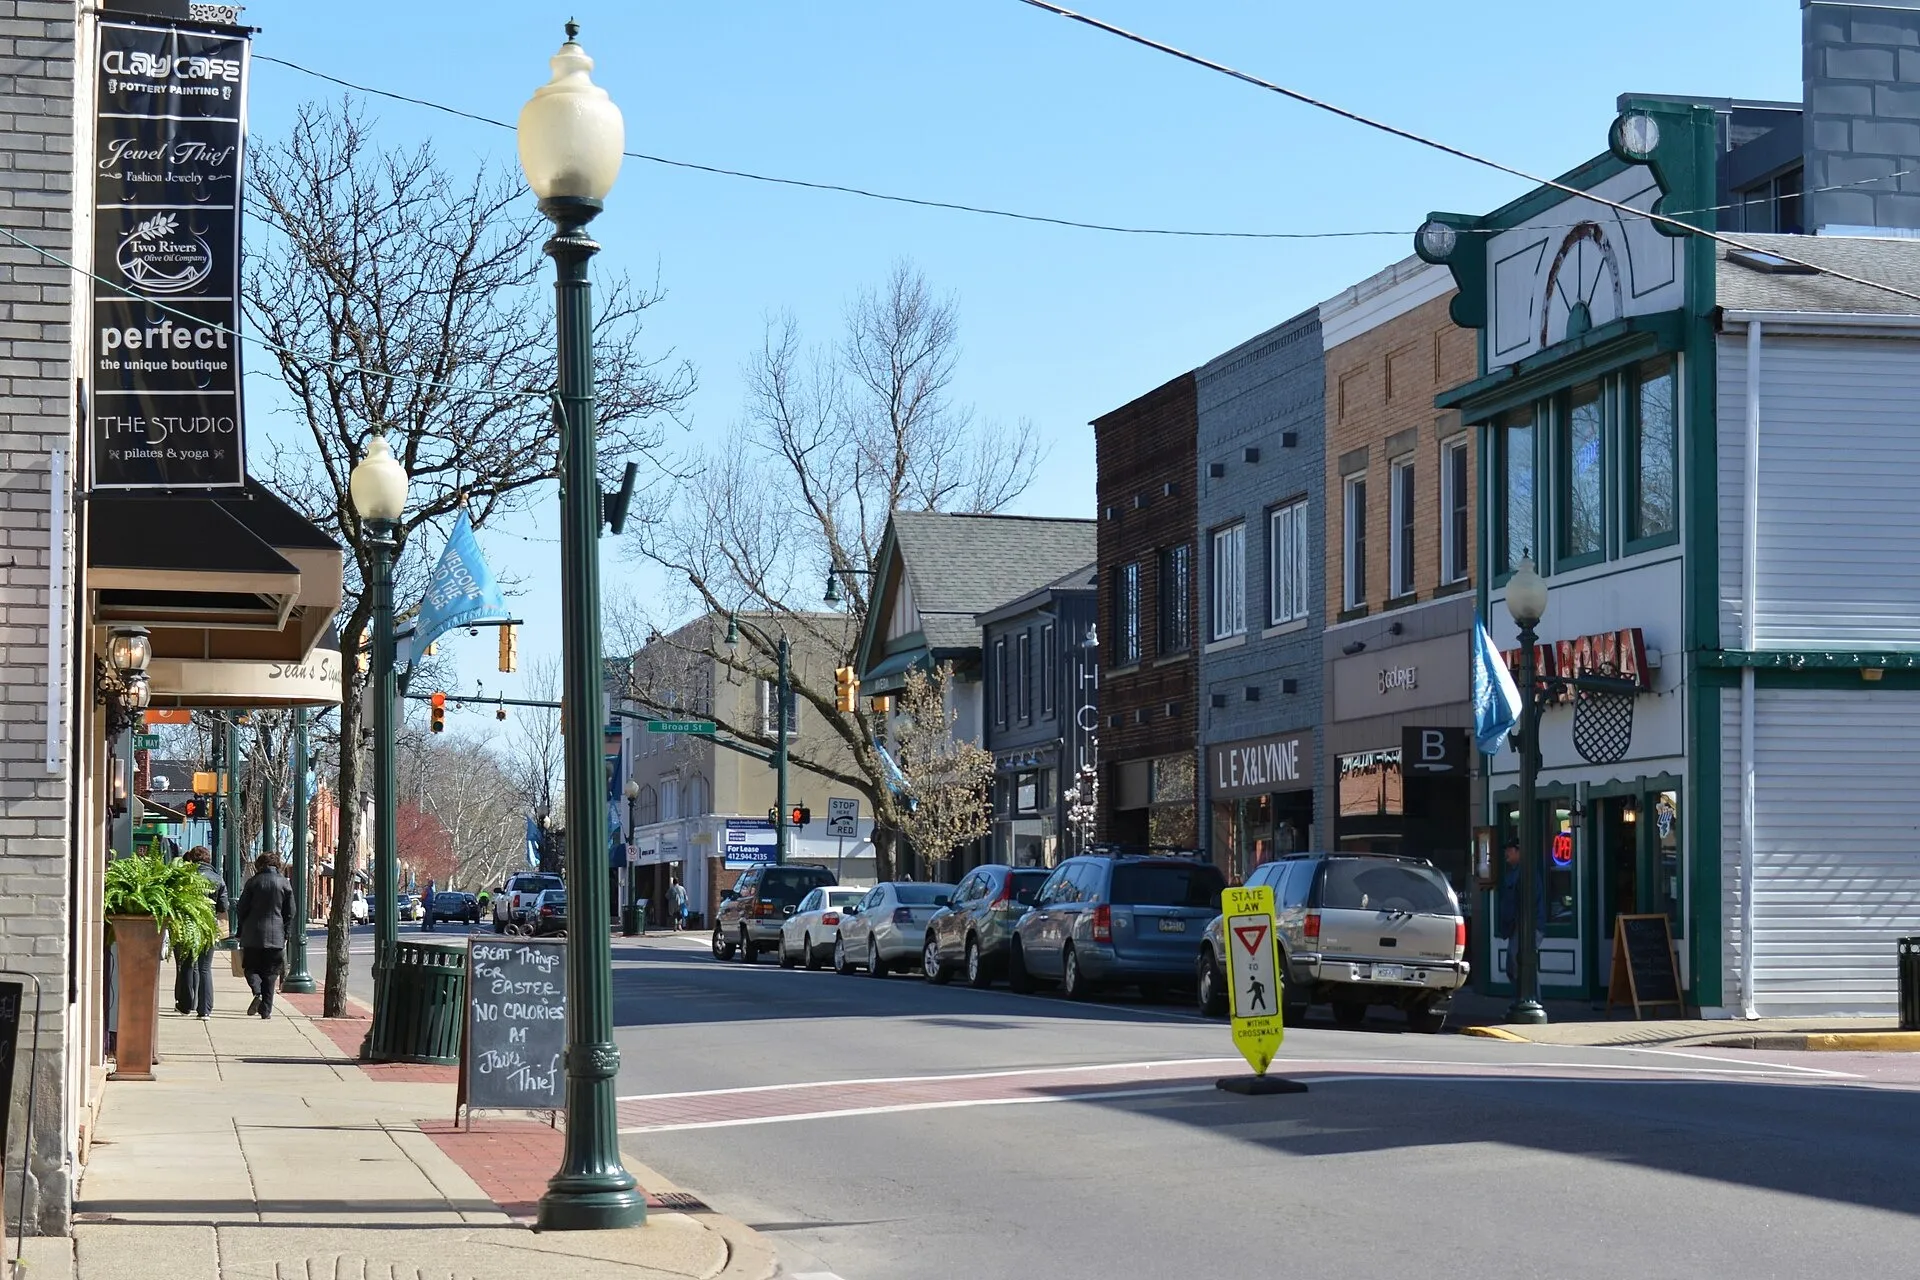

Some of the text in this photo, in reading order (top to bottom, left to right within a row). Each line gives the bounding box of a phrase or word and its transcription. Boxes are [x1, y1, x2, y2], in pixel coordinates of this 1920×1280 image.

[119, 82, 219, 96] POTTERY PAINTING
[99, 138, 235, 169] Jewel Thief
[127, 171, 203, 185] Fashion Jewelry
[130, 240, 197, 253] Two Rivers
[144, 253, 208, 264] Olive Oil Company
[101, 320, 228, 356] perfect
[100, 359, 228, 372] the unique boutique
[97, 416, 234, 444] THE STUDIO
[124, 448, 210, 460] pilates & yoga
[443, 548, 484, 600] WELCOME
[433, 564, 463, 600] TO THE
[662, 723, 689, 731] Broad
[1422, 730, 1446, 761] B
[832, 800, 855, 810] STOP
[837, 825, 854, 835] RED
[740, 845, 760, 853] Lease
[728, 852, 768, 861] 412.944.2135
[1231, 890, 1264, 902] STATE
[1237, 902, 1260, 913] LAW
[472, 944, 512, 960] GREAT
[475, 963, 506, 979] FOR
[1248, 963, 1259, 971] TO
[491, 980, 561, 996] EASTER
[1246, 1019, 1271, 1027] WITHIN
[1237, 1027, 1280, 1038] CROSSWALK
[507, 1053, 560, 1096] Thief
